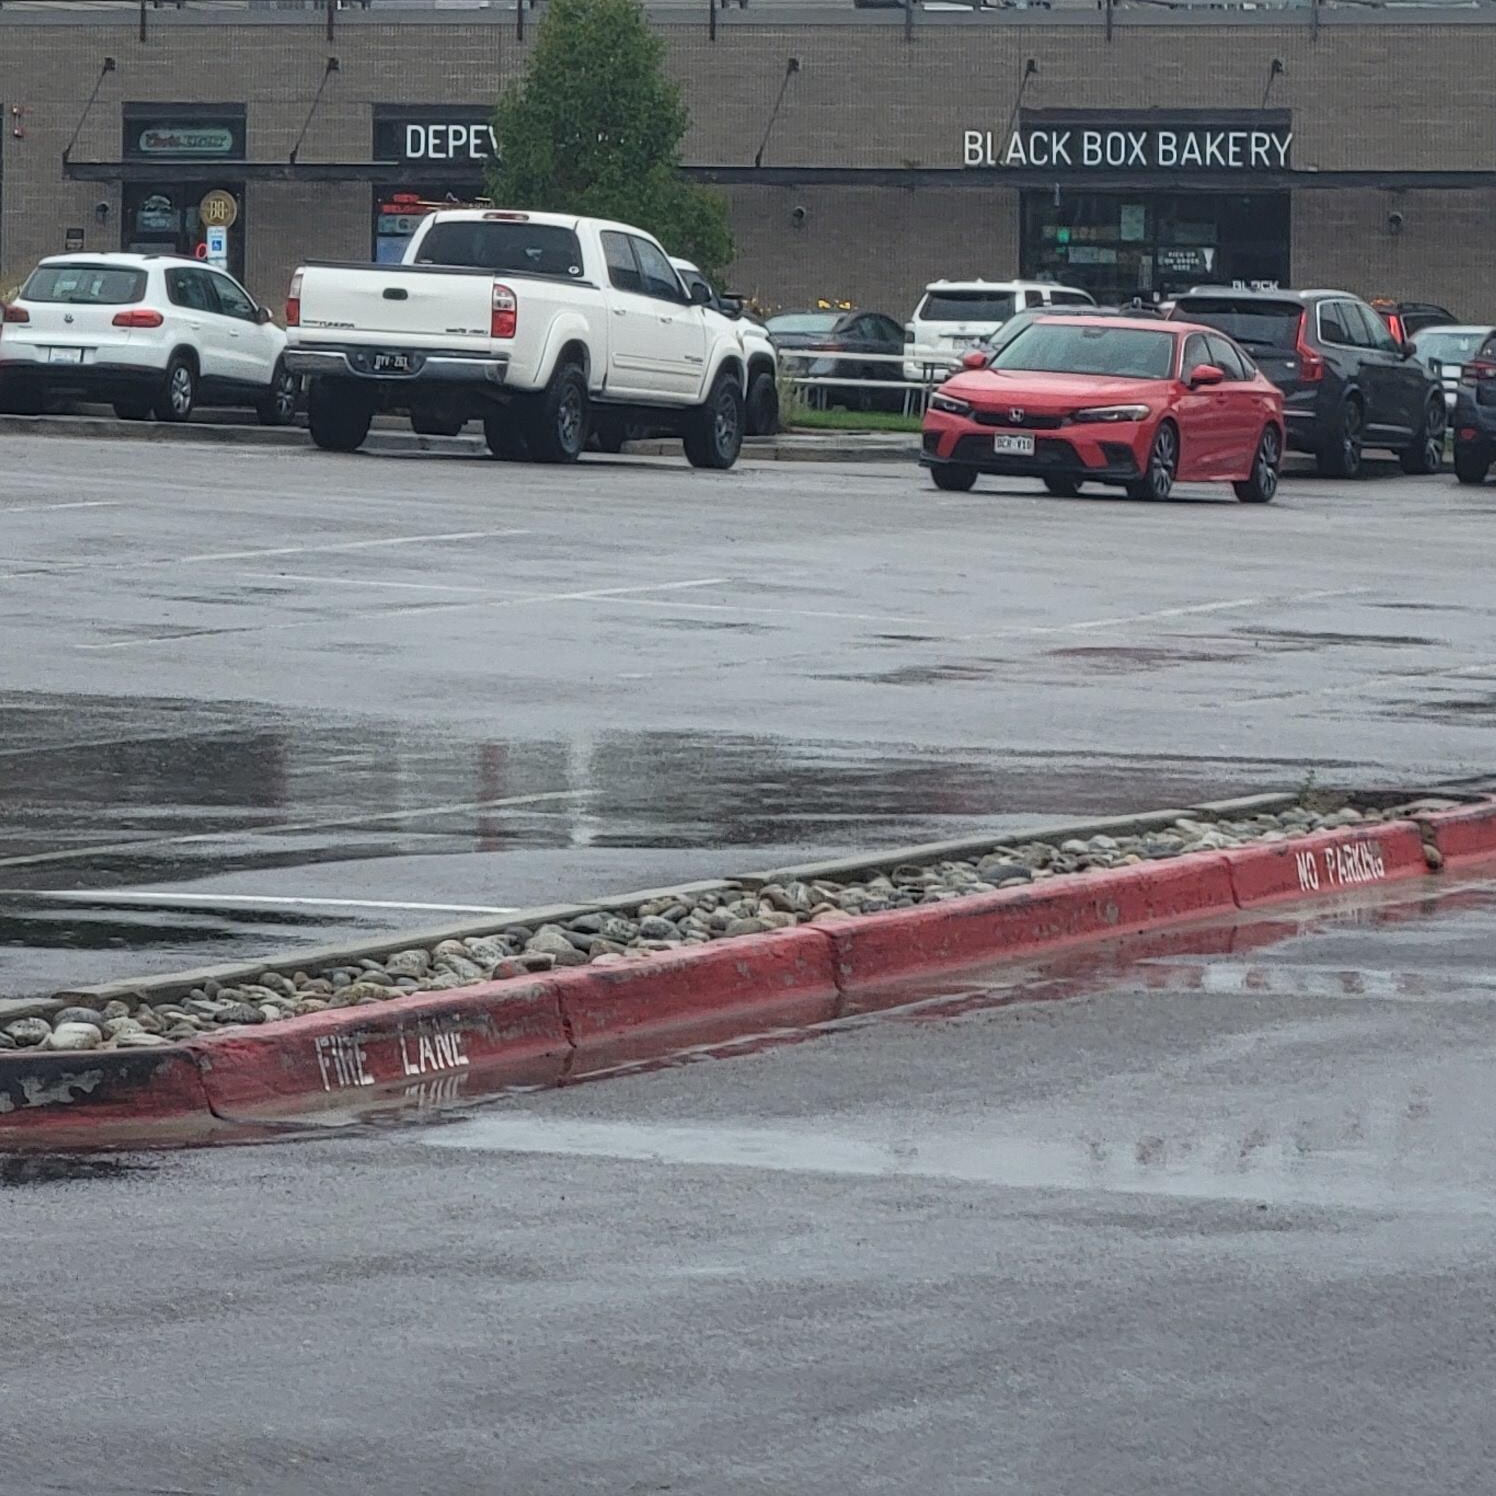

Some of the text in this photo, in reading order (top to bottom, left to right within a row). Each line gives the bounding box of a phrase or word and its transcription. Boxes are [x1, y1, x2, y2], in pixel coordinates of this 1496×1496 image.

[963, 130, 1293, 167] BLACK BOX BAKERY
[1296, 851, 1319, 892] NO
